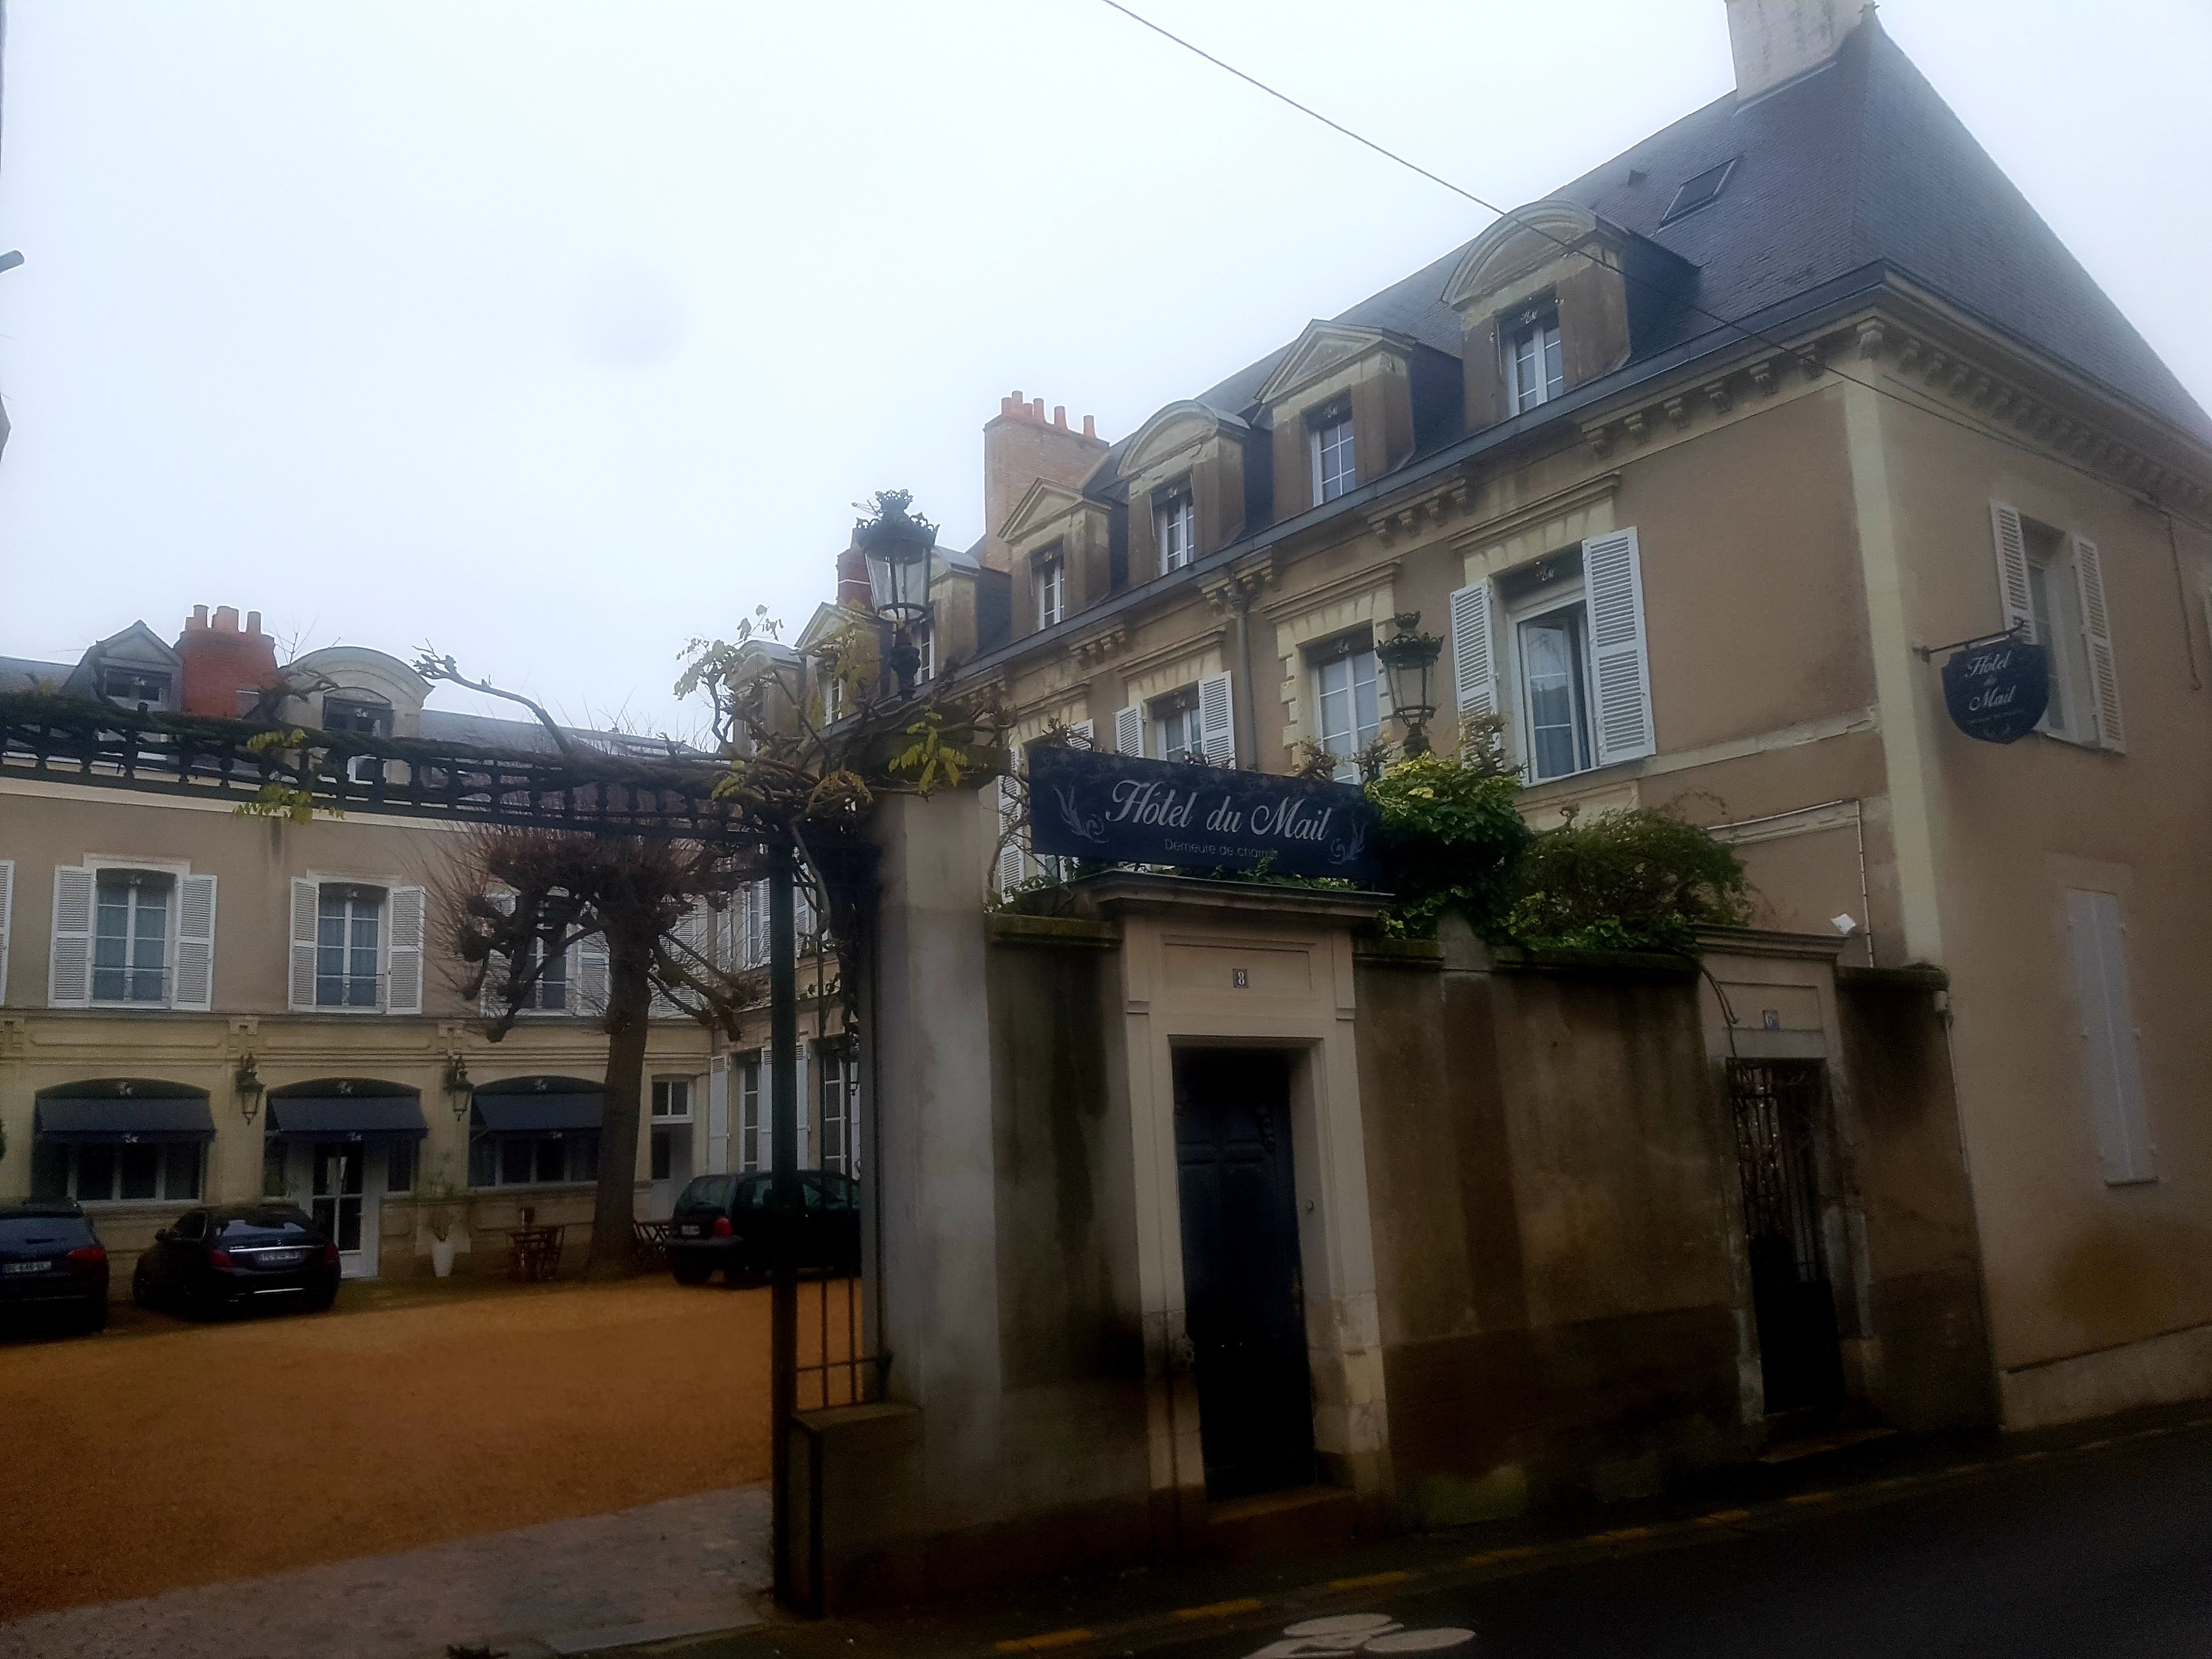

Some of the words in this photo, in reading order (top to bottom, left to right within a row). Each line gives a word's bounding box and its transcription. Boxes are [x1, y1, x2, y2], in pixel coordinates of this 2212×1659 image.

[1105, 779, 1198, 828] Hôtel
[1206, 795, 1243, 833] du
[1250, 797, 1332, 841] Mail
[1164, 838, 1216, 854] Demeure
[1220, 844, 1234, 856] de
[1237, 847, 1278, 859] charm
[1238, 970, 1245, 985] 8
